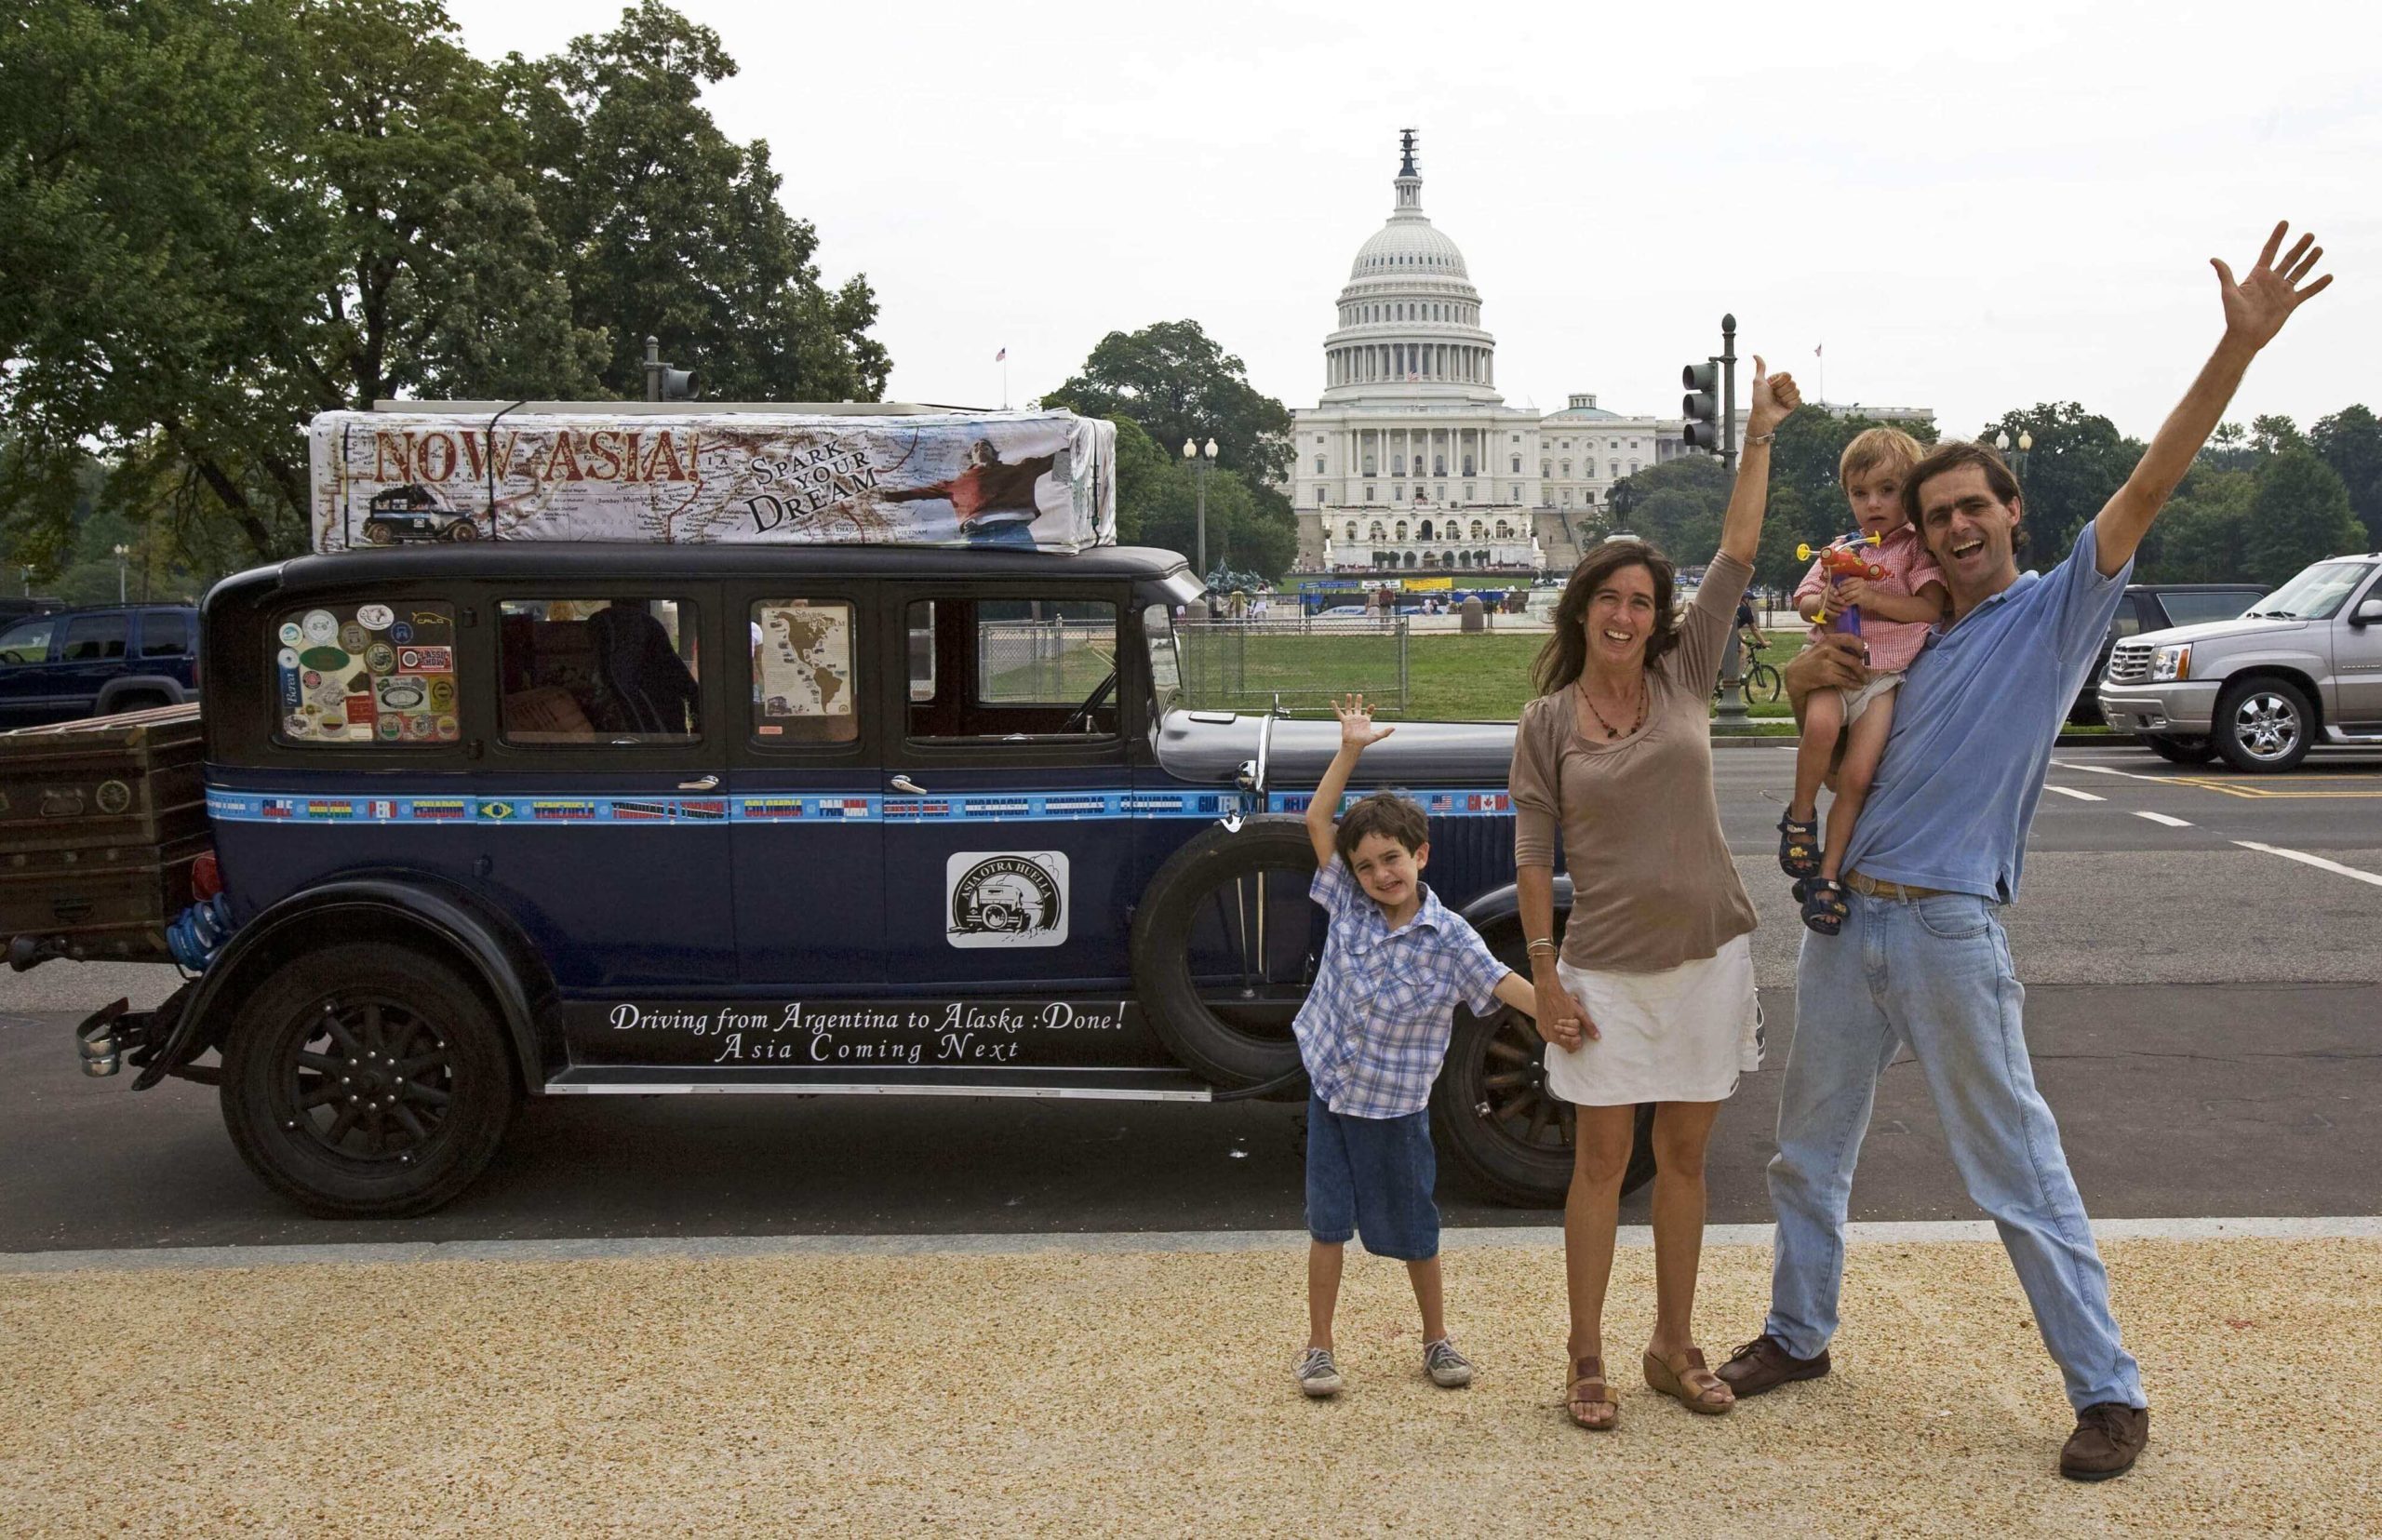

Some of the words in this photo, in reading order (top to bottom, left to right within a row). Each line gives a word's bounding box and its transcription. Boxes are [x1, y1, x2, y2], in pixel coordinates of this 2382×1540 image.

[374, 431, 520, 484] NOW
[542, 430, 700, 482] ASIA!
[751, 439, 846, 487] SPARK
[793, 451, 870, 490] YOUR
[623, 495, 649, 503] Mumbai
[743, 467, 880, 535] DREAM
[262, 800, 293, 817] CHILE
[308, 801, 353, 818] BOLIVIA
[368, 801, 397, 819] PERU
[413, 801, 465, 818] ECUADOR
[532, 801, 596, 819] VENEZUELA
[744, 799, 803, 817] COLOMBIA
[819, 799, 869, 816] PANAMA
[884, 800, 919, 817] COSTA
[923, 800, 949, 817] RICA
[1045, 797, 1104, 815] HONDURAS
[1467, 795, 1509, 811] CANADA
[961, 876, 982, 900] ASIA
[981, 862, 1013, 877] OTRA
[1015, 863, 1051, 899] HUELLA
[609, 1004, 708, 1035] Driving
[711, 1008, 769, 1035] from
[773, 1002, 899, 1035] Argentina
[908, 1011, 930, 1029] to
[934, 1002, 1024, 1034] Alaska
[715, 1033, 792, 1063] Asia
[810, 1033, 921, 1064] Coming
[937, 1032, 1019, 1063] Next
